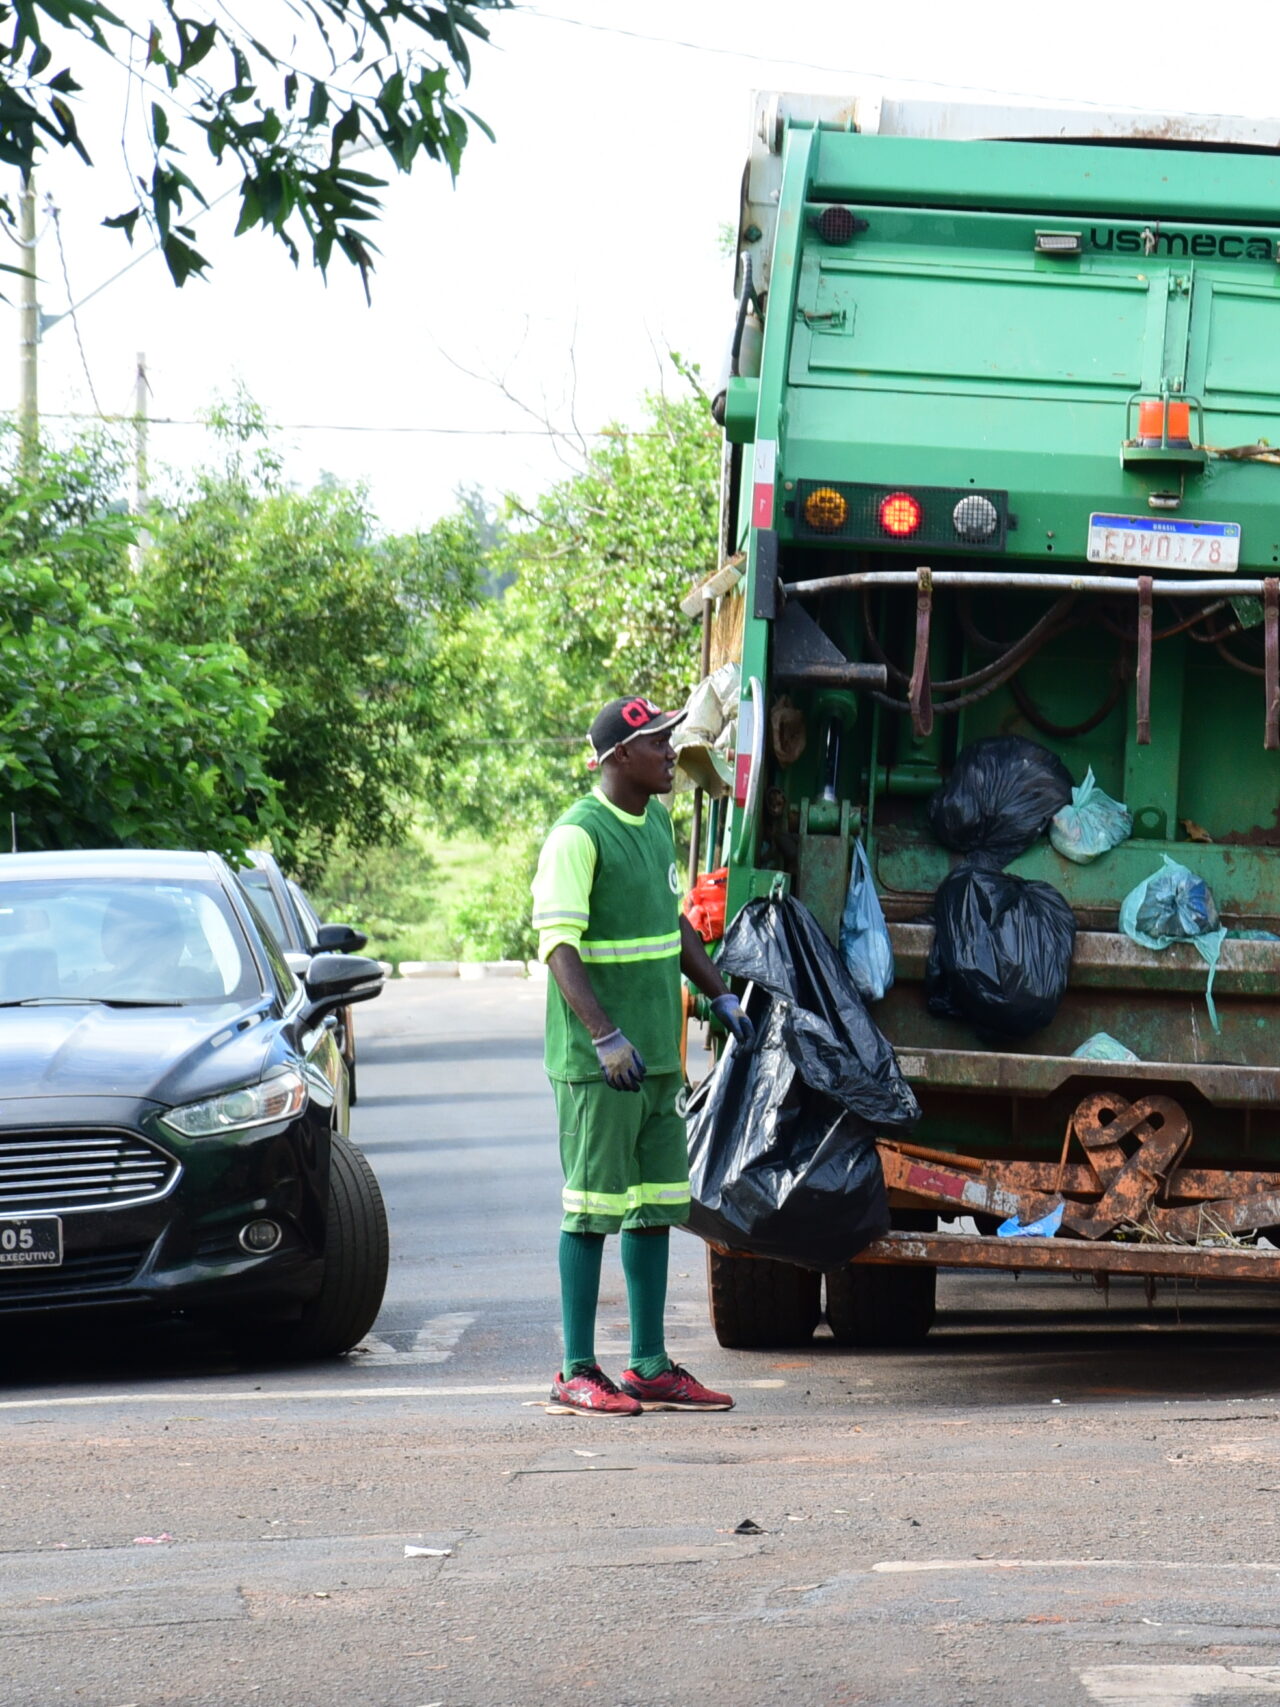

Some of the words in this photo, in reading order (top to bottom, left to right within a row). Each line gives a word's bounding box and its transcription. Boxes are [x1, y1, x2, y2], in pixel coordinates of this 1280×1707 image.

[1152, 523, 1177, 533] BRASIL
[1, 1228, 34, 1250] 05
[0, 1252, 56, 1262] EXECUTIVO
